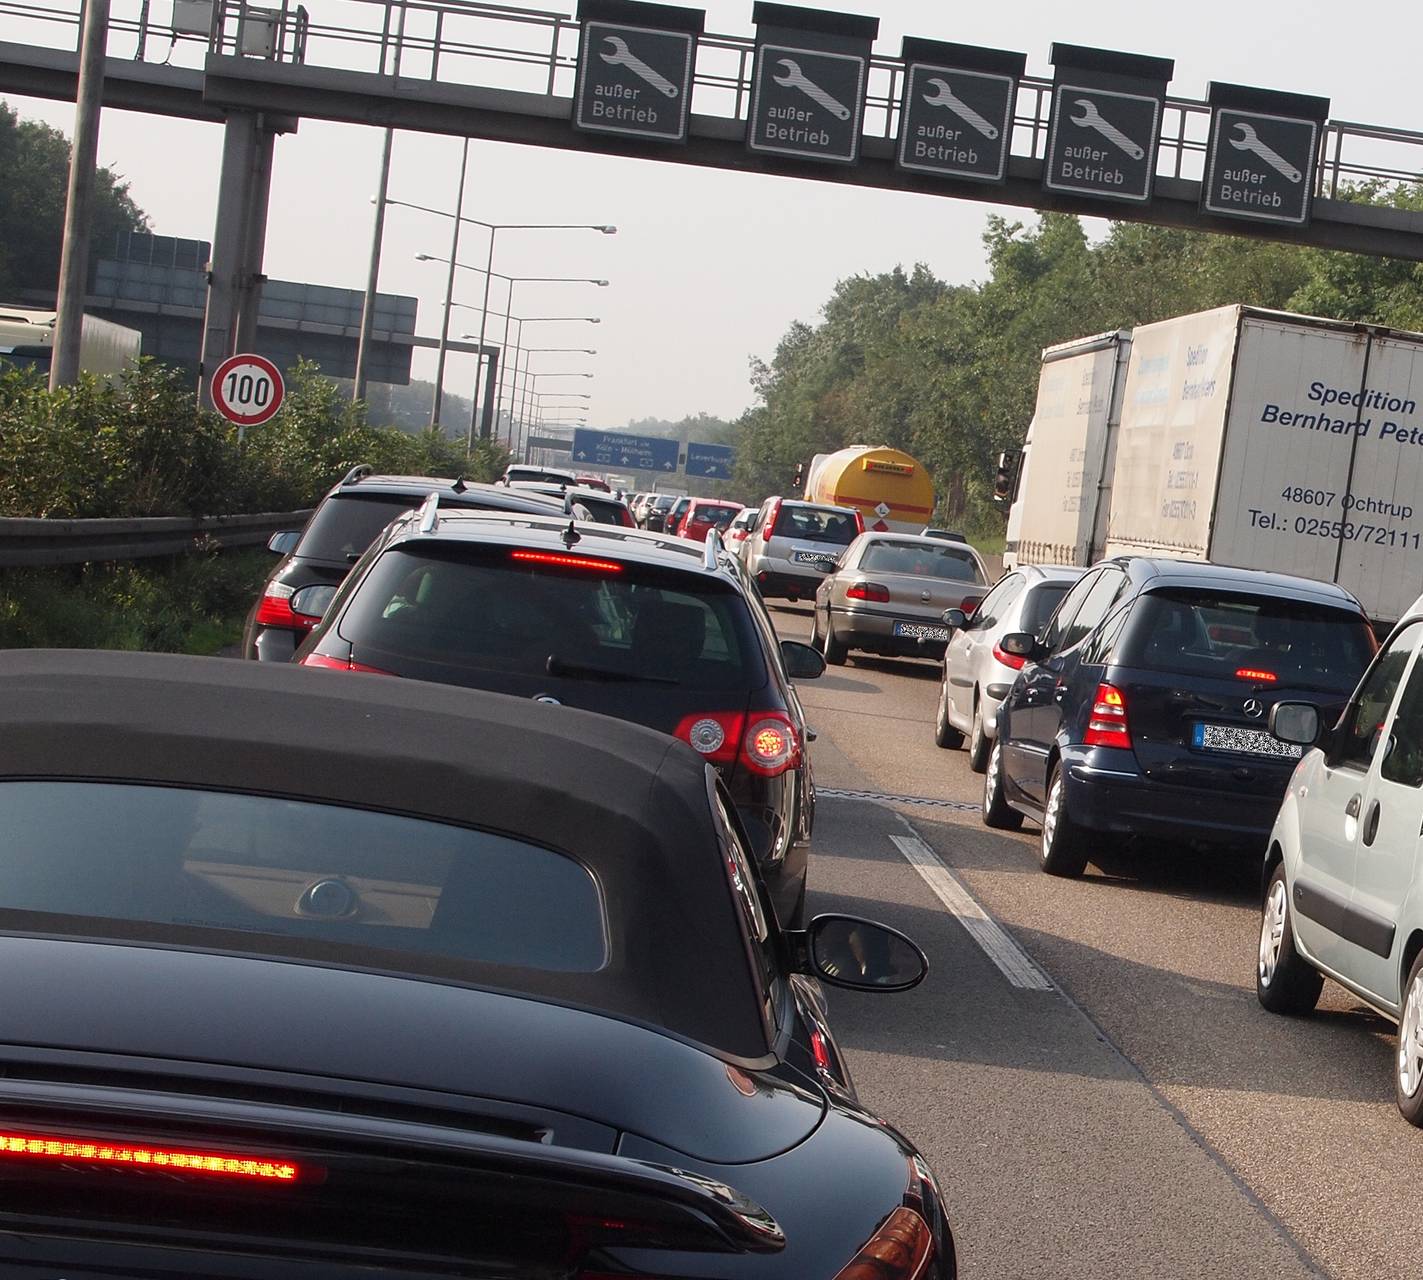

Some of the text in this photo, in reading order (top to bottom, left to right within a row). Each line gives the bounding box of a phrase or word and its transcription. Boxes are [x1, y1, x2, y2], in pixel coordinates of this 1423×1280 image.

[594, 82, 641, 100] außer
[592, 101, 658, 124] Betrieb
[767, 105, 813, 123] außer
[765, 123, 830, 146] Betrieb
[917, 124, 962, 141] außer
[915, 141, 978, 165] Betrieb
[1064, 145, 1109, 162] außer
[1061, 162, 1124, 185] Betrieb
[1222, 168, 1267, 185] außer
[1220, 185, 1282, 208] Betrieb
[228, 373, 270, 407] 100
[1307, 382, 1416, 415] Spedition
[1261, 404, 1372, 437] Bernhard
[1281, 486, 1413, 520] 48607 Ochtrup
[1248, 509, 1288, 532] Tel.:
